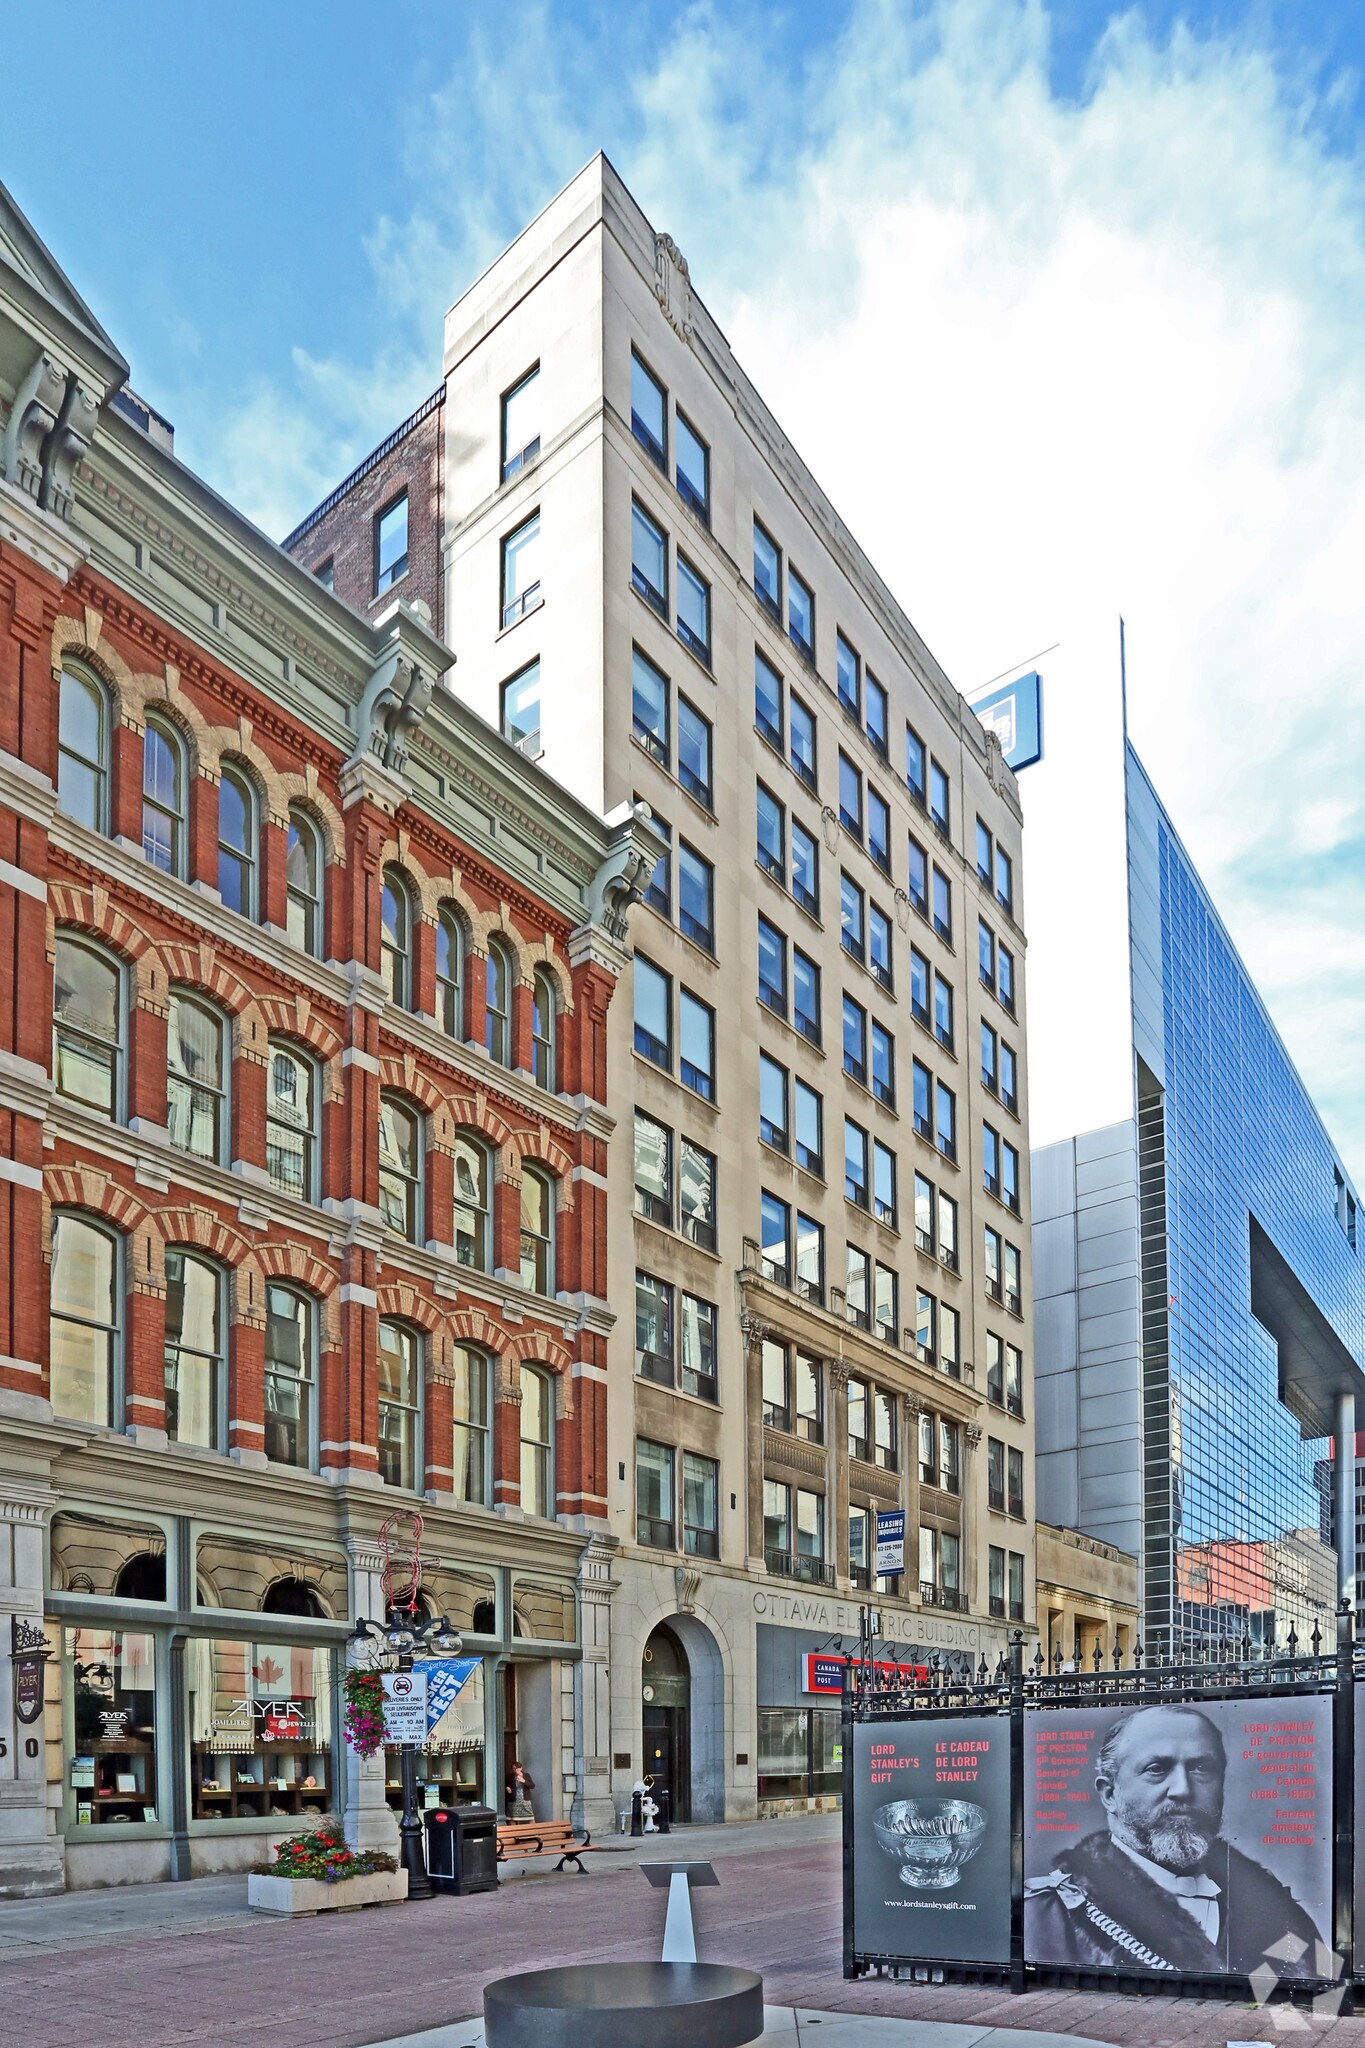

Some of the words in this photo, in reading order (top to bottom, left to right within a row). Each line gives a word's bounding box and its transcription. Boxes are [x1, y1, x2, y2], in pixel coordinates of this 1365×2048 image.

[878, 1519, 903, 1529] LEASING
[752, 1591, 829, 1625] OTTAWA
[917, 1620, 977, 1647] BUILDING
[644, 1645, 653, 1662] 6
[817, 1664, 840, 1673] CANADA
[817, 1676, 831, 1684] POST
[428, 1674, 463, 1720] FEST
[1243, 1723, 1270, 1734] LORD
[1272, 1721, 1315, 1732] STANLEY
[1035, 1732, 1058, 1742] LORD
[1060, 1730, 1095, 1741] STANLEY
[1250, 1738, 1264, 1747] DE
[1268, 1735, 1316, 1746] PRESTON
[871, 1744, 895, 1755] LORD
[935, 1742, 947, 1753] LE
[950, 1741, 989, 1752] CADEAU
[1035, 1744, 1047, 1754] OF
[1049, 1743, 1087, 1753] PRESTON
[1050, 1756, 1089, 1766] Governor
[1256, 1750, 1314, 1762] gouverneur
[871, 1758, 920, 1770] STANLEY'S
[935, 1757, 949, 1768] DE
[951, 1756, 978, 1767] LORD
[1302, 1763, 1315, 1773] du
[871, 1772, 892, 1783] GIFT
[935, 1771, 978, 1782] STANLEY
[1276, 1776, 1316, 1787] Canada
[1035, 1780, 1068, 1790] Canada
[1035, 1809, 1067, 1821] Hockey
[1275, 1809, 1315, 1820] Fervent
[1271, 1823, 1315, 1833] amateur
[1263, 1834, 1275, 1845] de
[1277, 1834, 1315, 1847] hockey
[883, 1900, 977, 1911] www.lordstanleysgift.com
